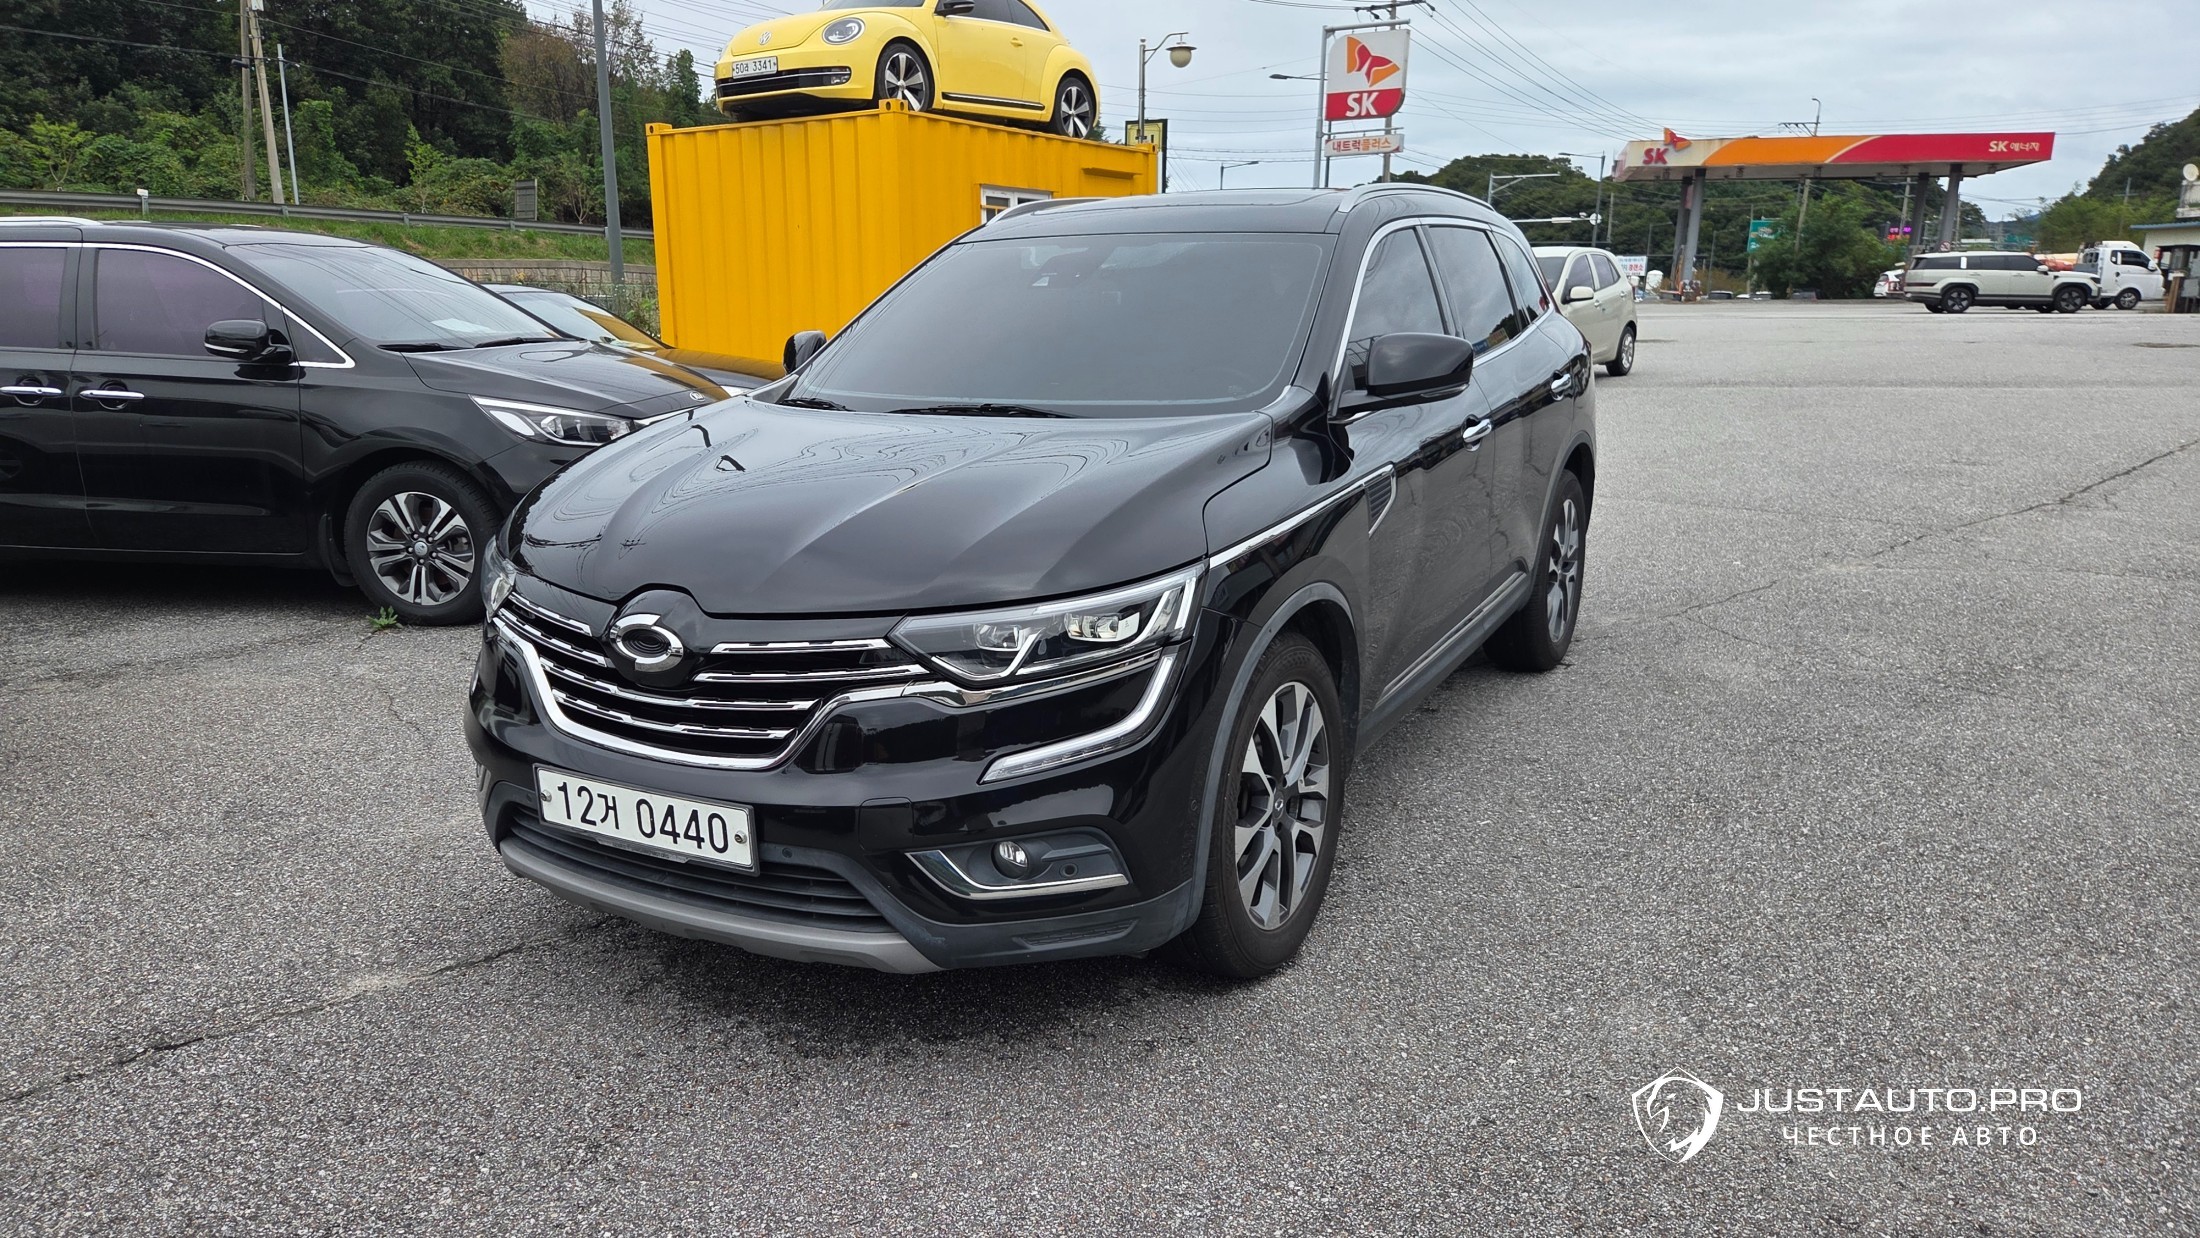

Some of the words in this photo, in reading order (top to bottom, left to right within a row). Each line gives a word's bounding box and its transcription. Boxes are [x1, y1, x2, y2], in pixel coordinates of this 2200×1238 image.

[752, 59, 772, 72] 3341
[1345, 92, 1379, 117] SK
[1332, 137, 1392, 152] 내트럭플러스
[1988, 140, 2009, 152] SK
[2010, 142, 2040, 152] 에너지
[1642, 147, 1669, 165] SK
[557, 781, 620, 830] 12거
[636, 798, 729, 853] 0440
